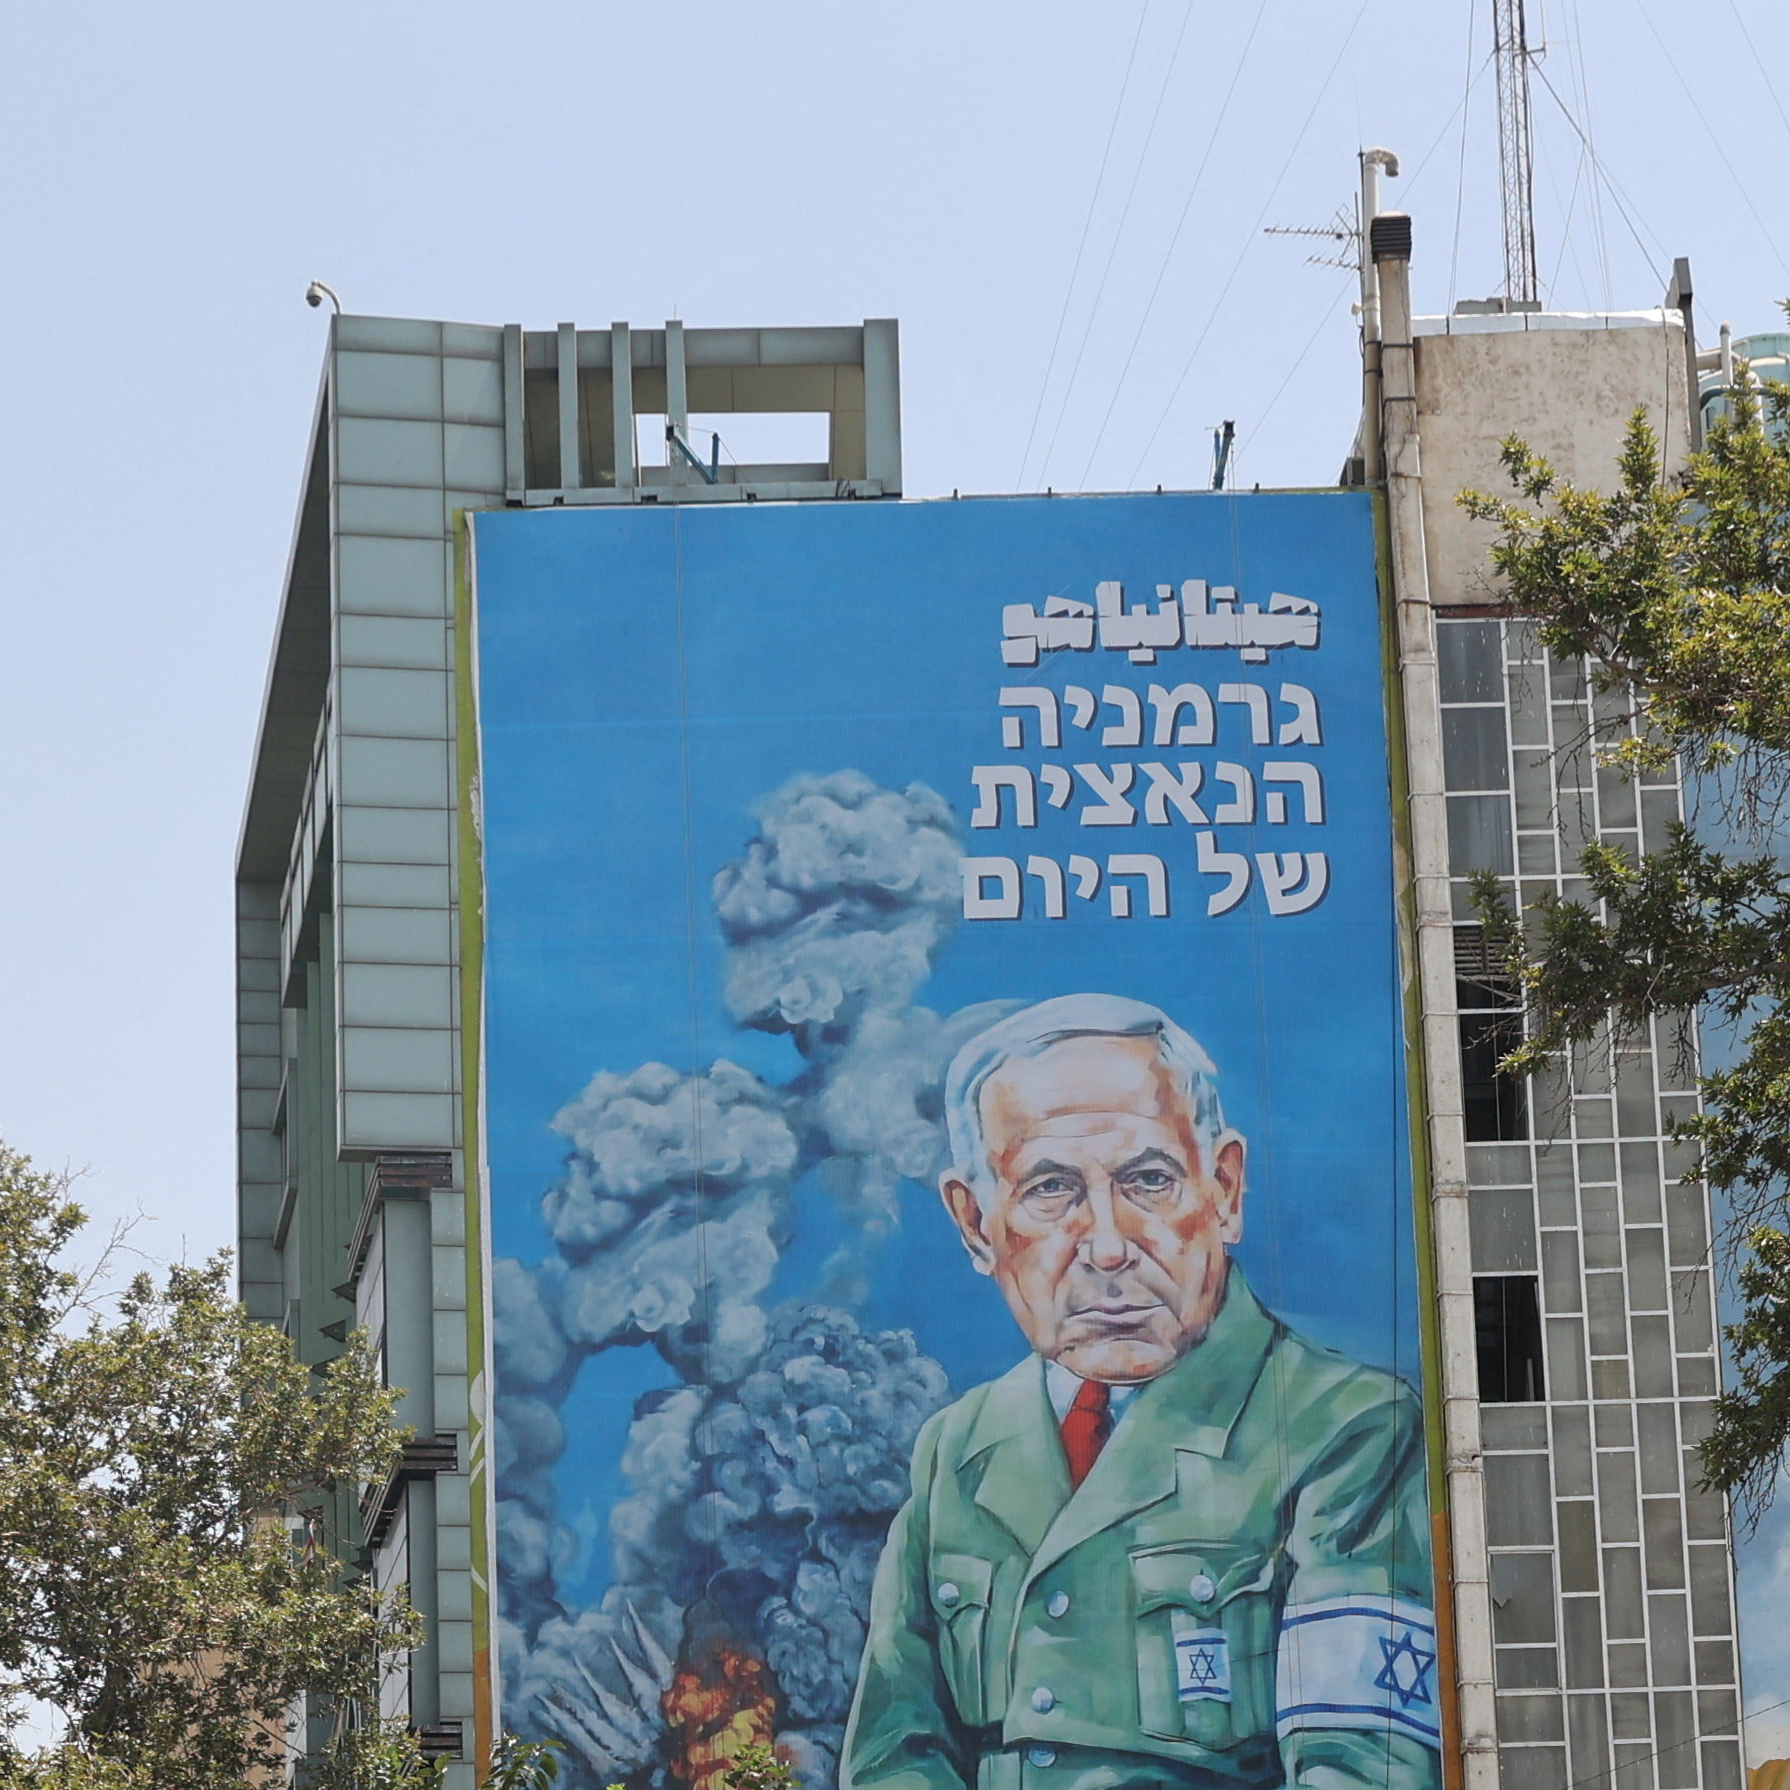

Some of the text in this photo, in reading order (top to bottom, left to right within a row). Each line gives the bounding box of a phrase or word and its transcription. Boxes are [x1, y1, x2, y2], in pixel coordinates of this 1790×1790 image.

[998, 682, 1323, 748] גרמניה
[970, 760, 1324, 829] הנאצית
[962, 830, 1329, 919] של היום
